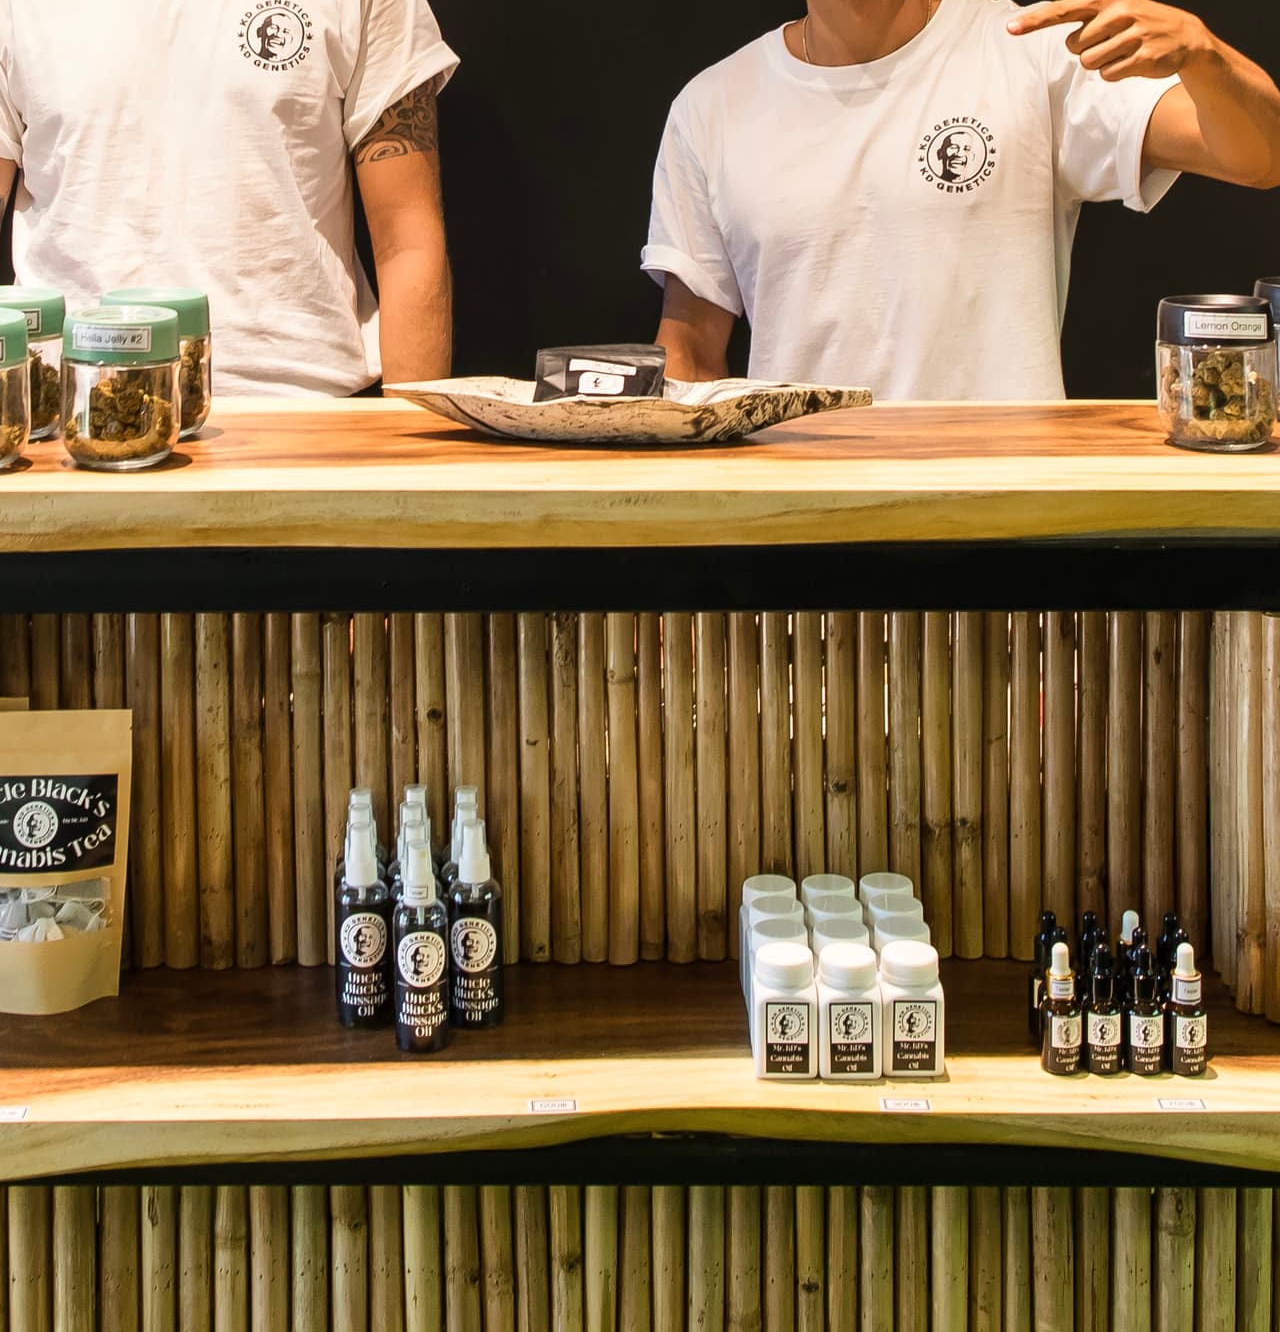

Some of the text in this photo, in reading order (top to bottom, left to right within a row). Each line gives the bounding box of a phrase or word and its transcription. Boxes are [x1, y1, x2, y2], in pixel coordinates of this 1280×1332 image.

[240, 0, 313, 28] KD GENETICS
[238, 44, 310, 71] KD GENETICS
[918, 117, 994, 150] KD GENETICS
[920, 160, 995, 193] KD GENETICS
[1194, 320, 1262, 333] Lemon Orange
[68, 823, 112, 858] Tea
[415, 1026, 432, 1036] Oil
